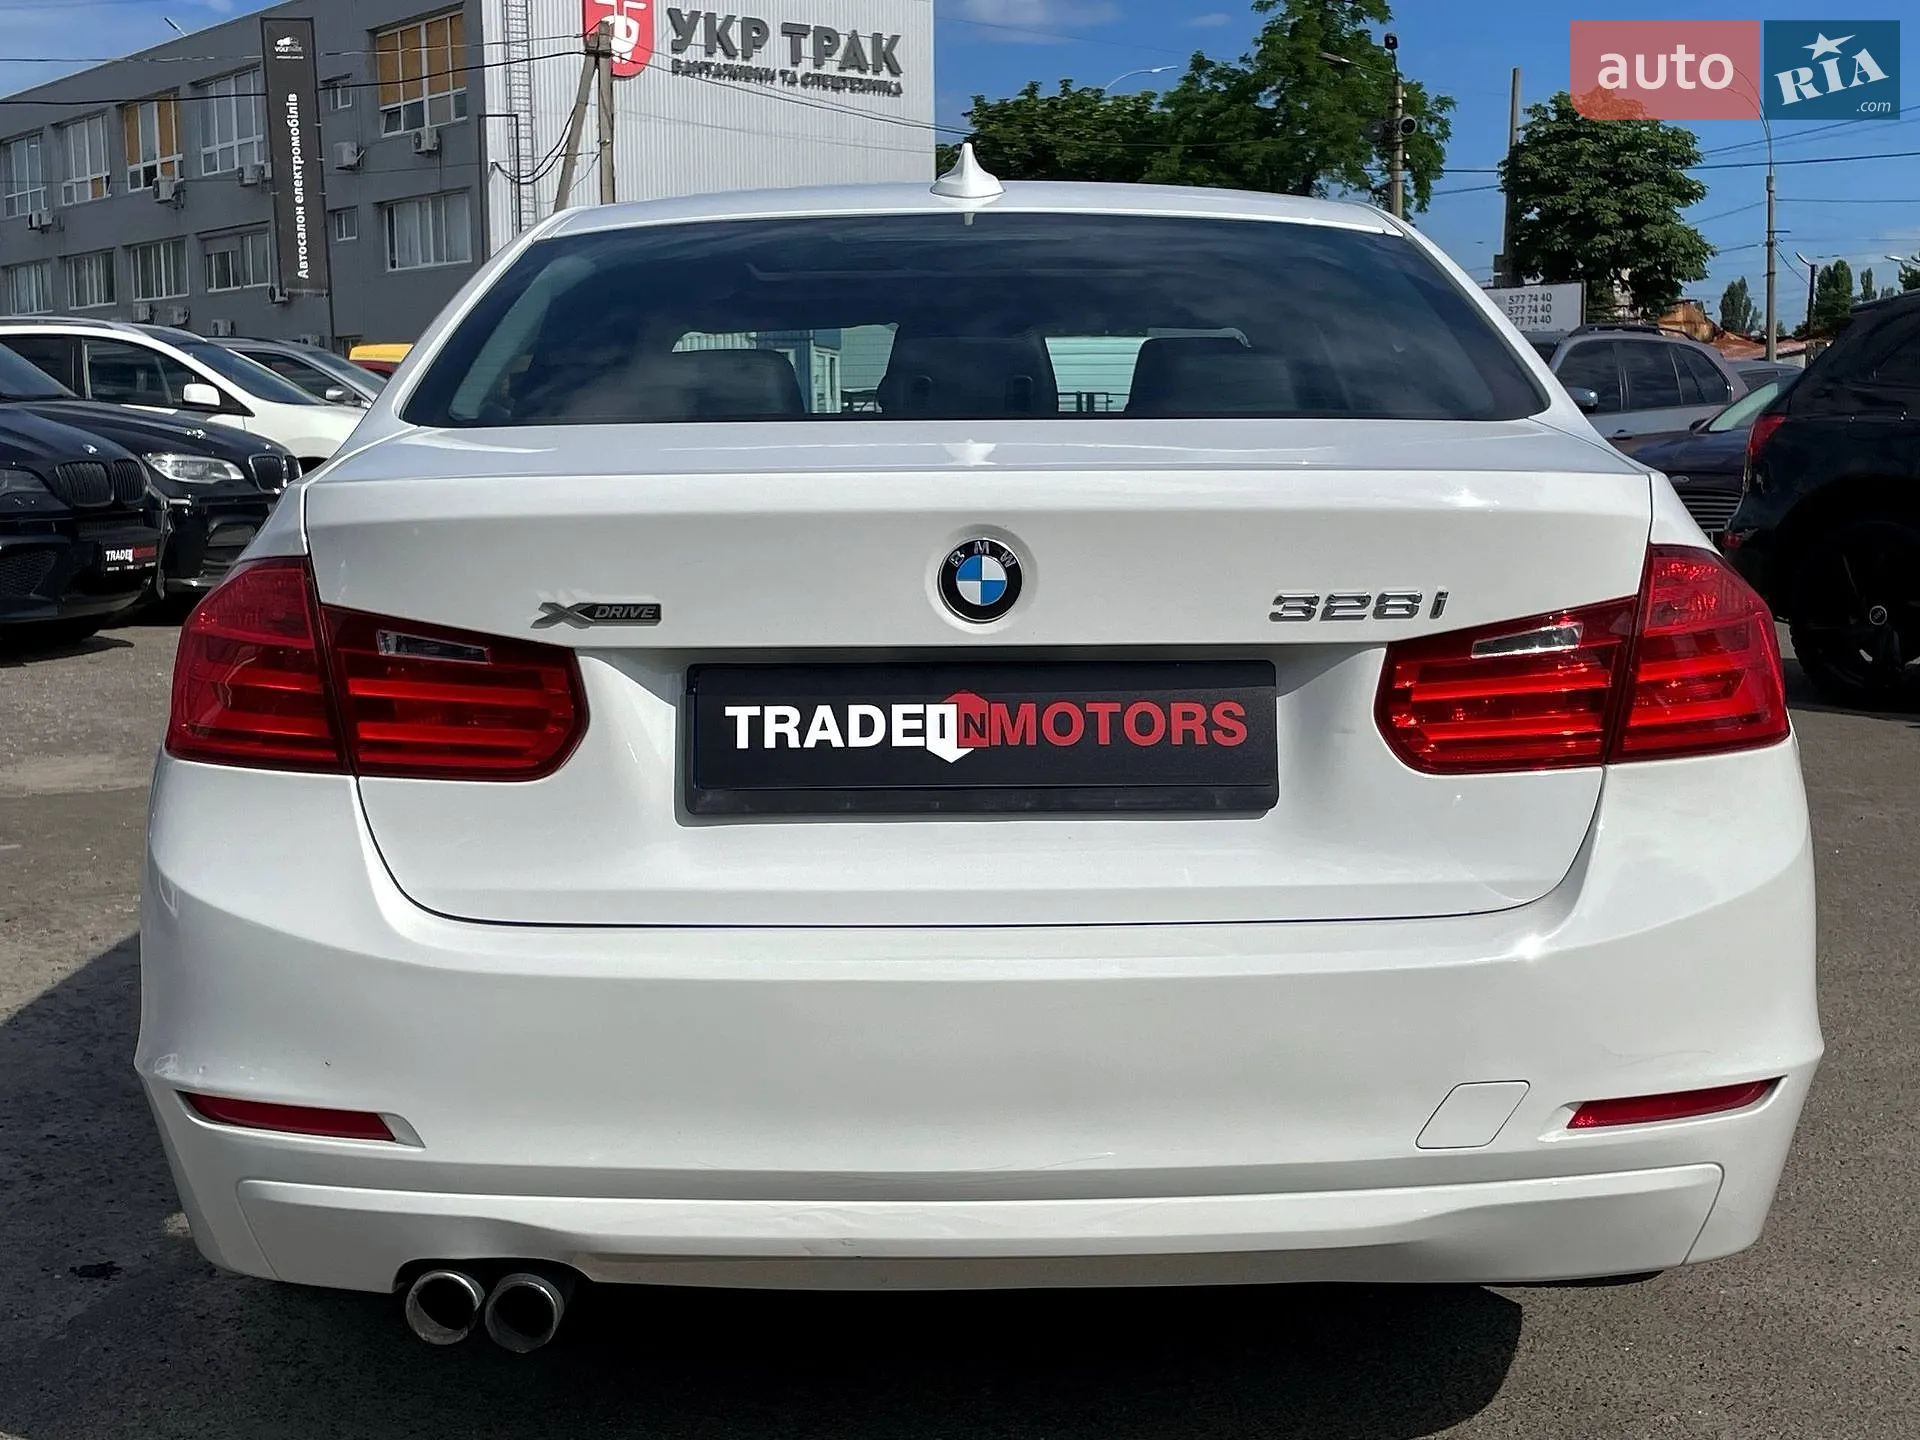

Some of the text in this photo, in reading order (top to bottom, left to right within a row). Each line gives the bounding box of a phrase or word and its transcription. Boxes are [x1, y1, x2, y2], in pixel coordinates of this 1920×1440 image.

[667, 8, 903, 77] УКР ТРАК
[286, 93, 309, 279] Автосалон електромобілів
[1507, 303, 1552, 316] 577 74 40
[1508, 292, 1552, 305] 577 74 40
[1527, 315, 1538, 325] 74
[1540, 314, 1552, 324] 40
[949, 540, 1017, 568] BMW
[1268, 589, 1450, 622] 328i
